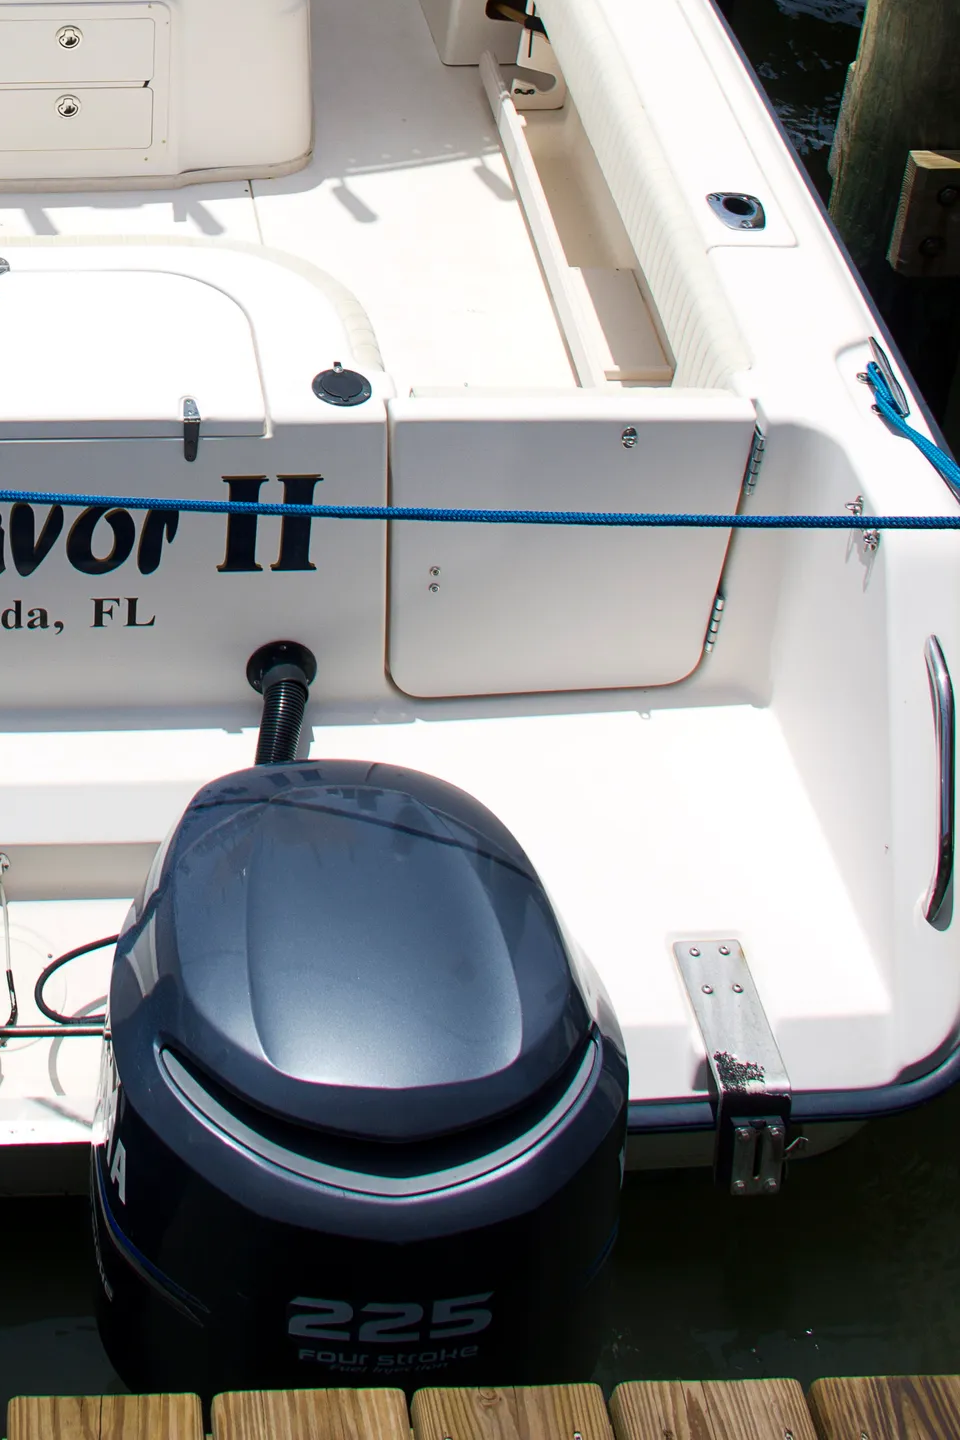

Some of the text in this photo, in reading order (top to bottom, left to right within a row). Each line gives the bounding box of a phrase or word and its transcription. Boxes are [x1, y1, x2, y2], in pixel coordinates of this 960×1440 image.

[216, 474, 324, 573] II
[90, 597, 157, 628] FL
[287, 1290, 496, 1343] 225
